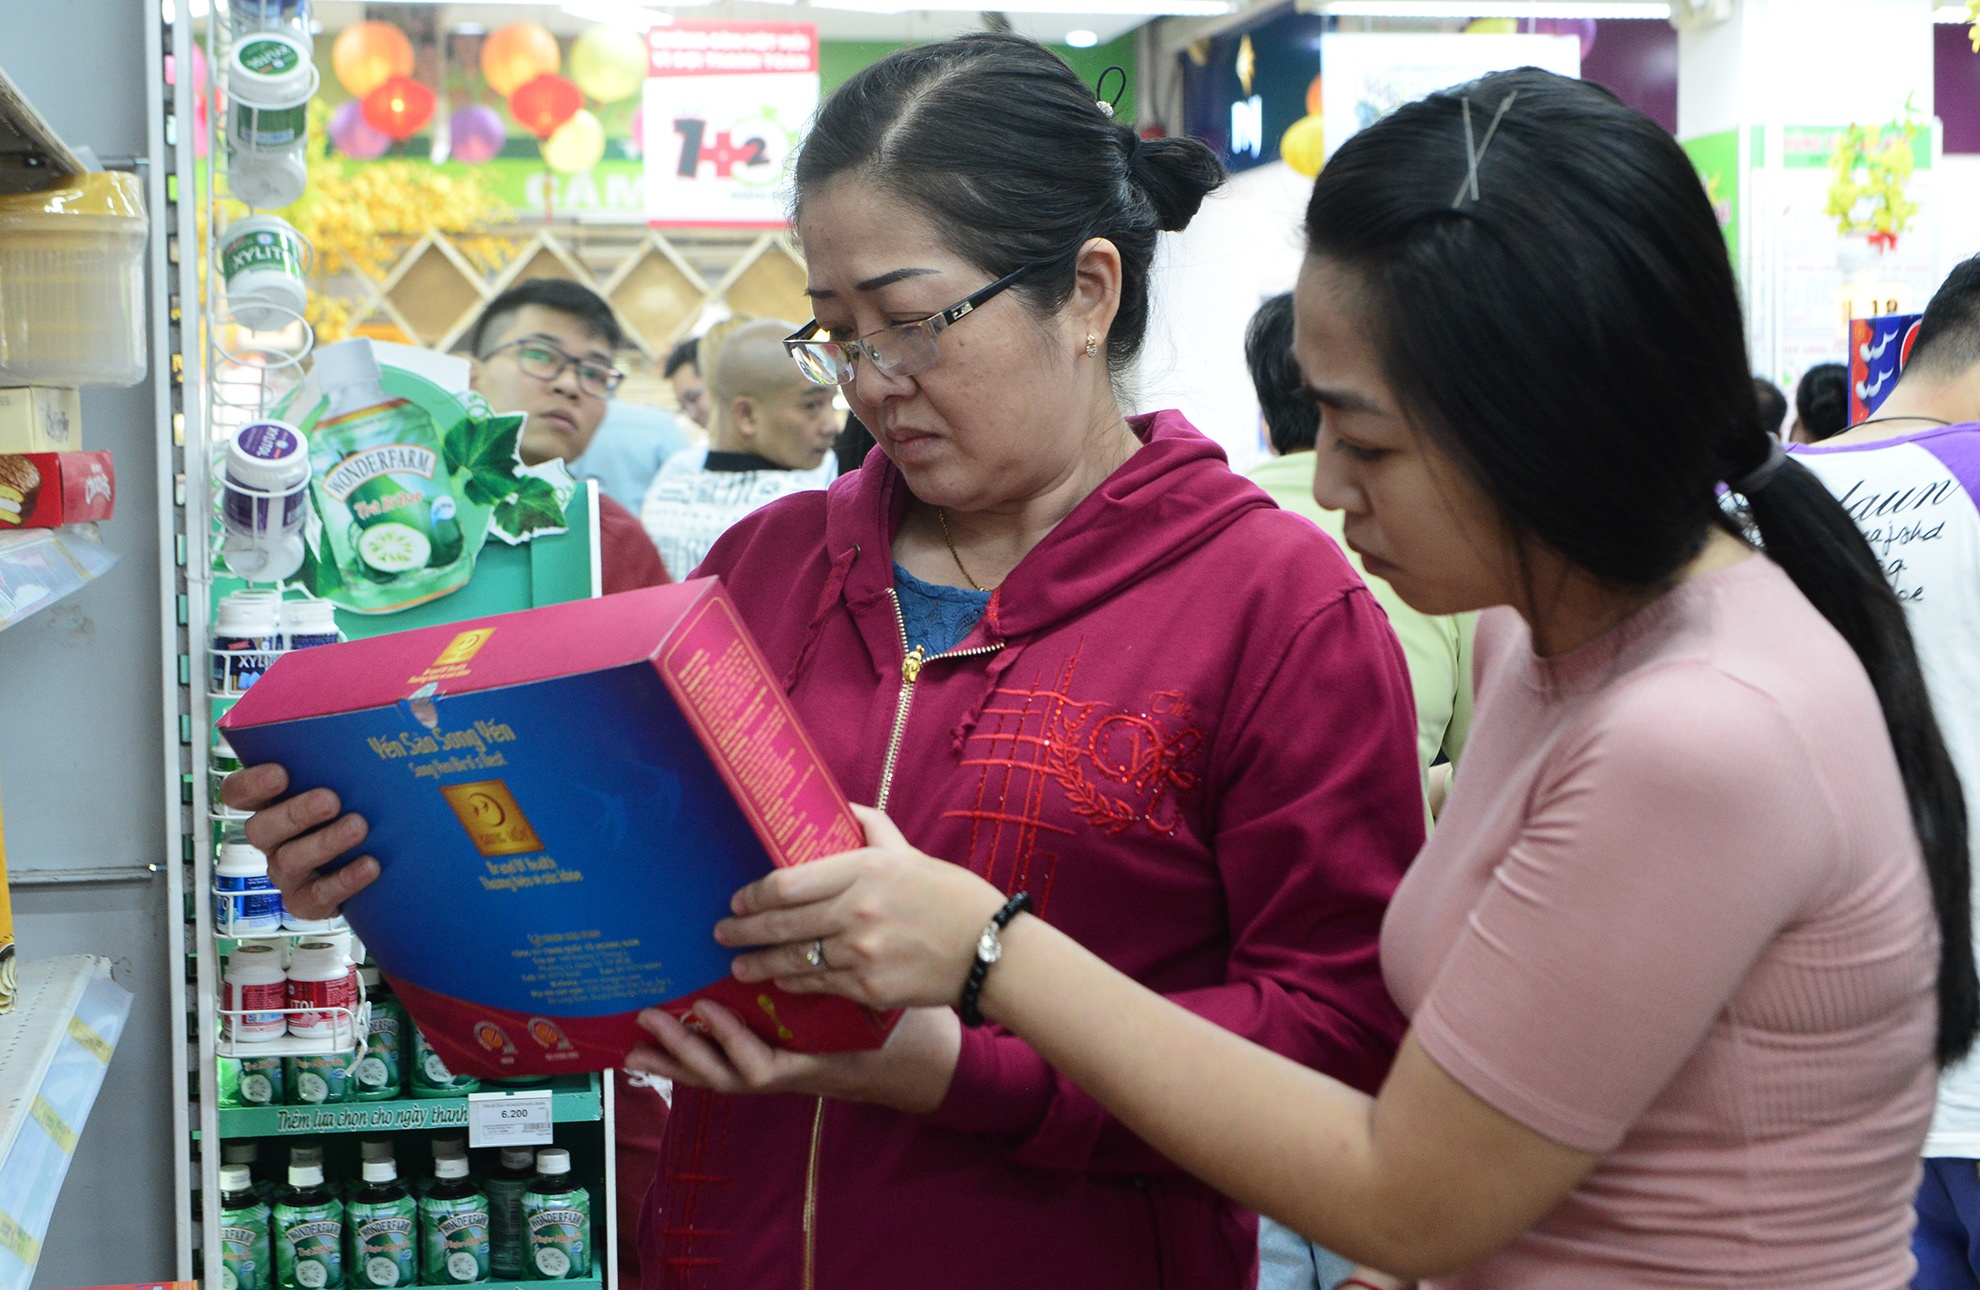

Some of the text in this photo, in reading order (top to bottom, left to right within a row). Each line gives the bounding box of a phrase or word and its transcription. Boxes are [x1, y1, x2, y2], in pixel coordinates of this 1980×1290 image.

[327, 447, 431, 495] WONDERFARM
[278, 1103, 469, 1133] Thêm lựa chọn cho ngày thanh
[501, 1109, 528, 1119] 6.200
